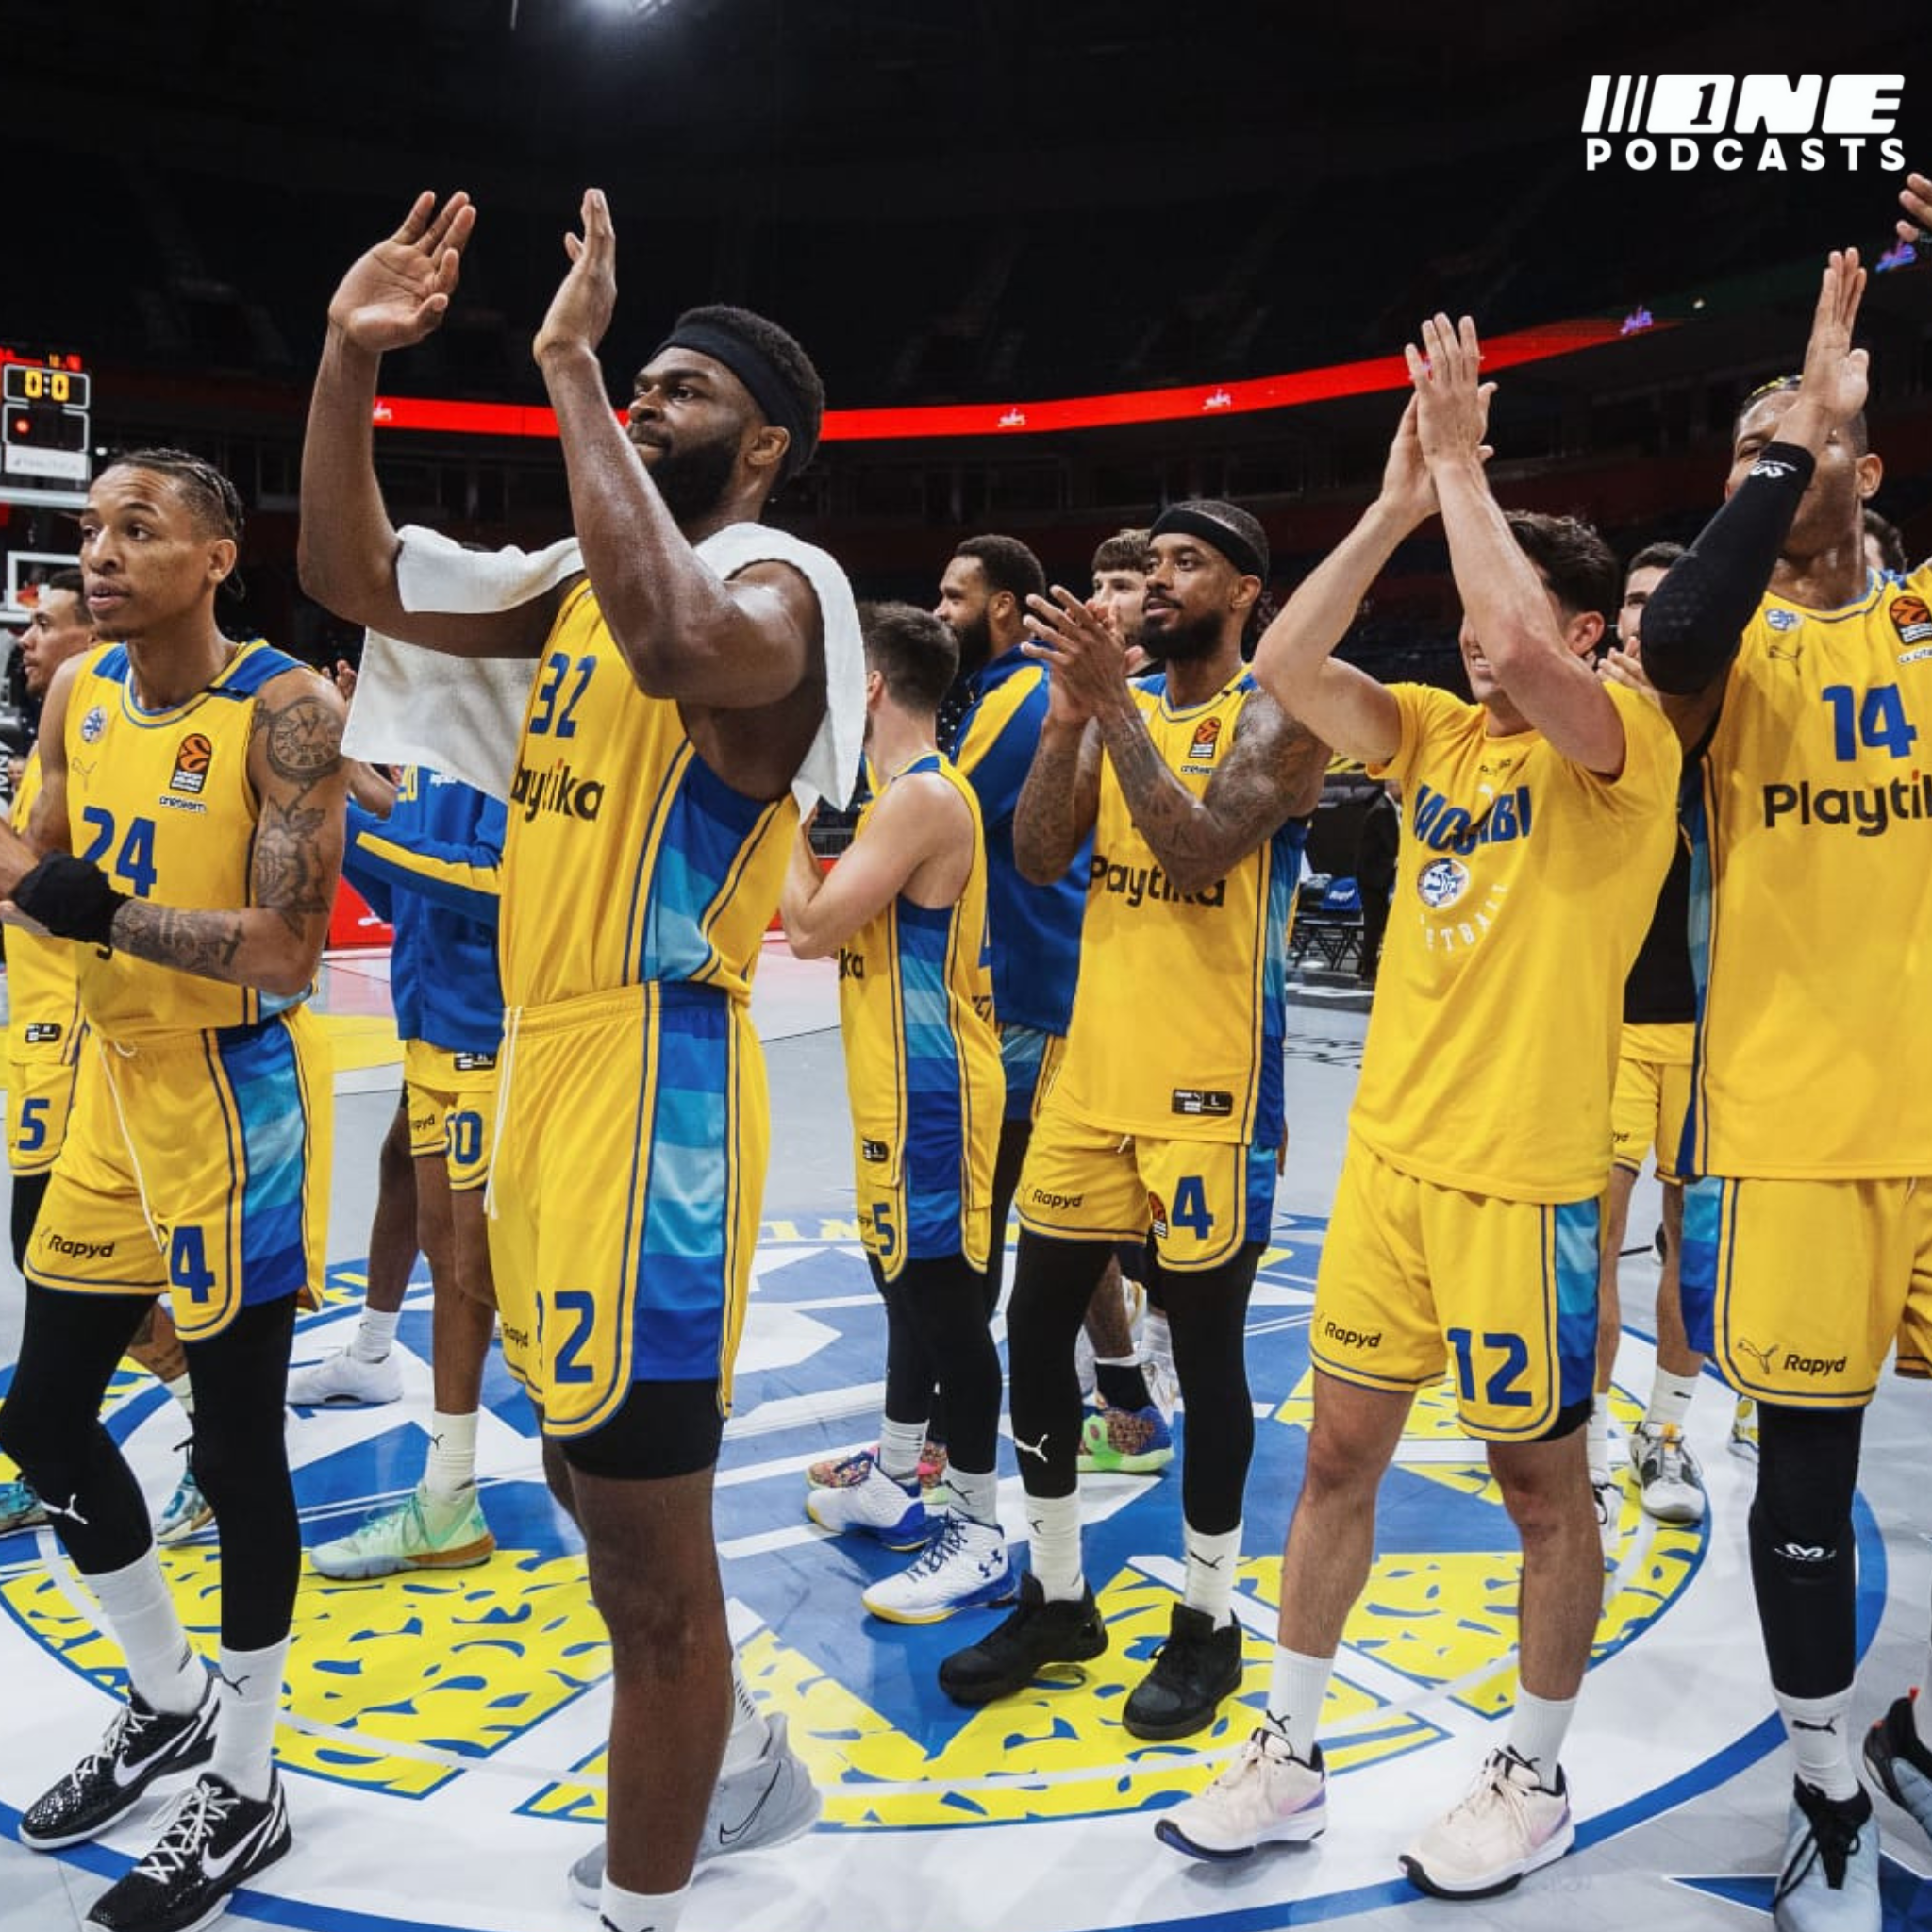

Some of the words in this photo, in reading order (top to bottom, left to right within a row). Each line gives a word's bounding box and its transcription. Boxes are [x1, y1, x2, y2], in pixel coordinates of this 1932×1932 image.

[529, 652, 597, 738] 32
[1821, 683, 1917, 762] 14
[81, 805, 158, 898] 24
[18, 1098, 51, 1151] 5
[1032, 1189, 1084, 1209] Rapyd
[1171, 1175, 1214, 1240] 4
[48, 1235, 115, 1259] Rapyd
[872, 1202, 896, 1256] 5
[1325, 1322, 1381, 1349] Rapyd
[1447, 1327, 1533, 1407] 12
[1784, 1353, 1847, 1376] Rapyd
